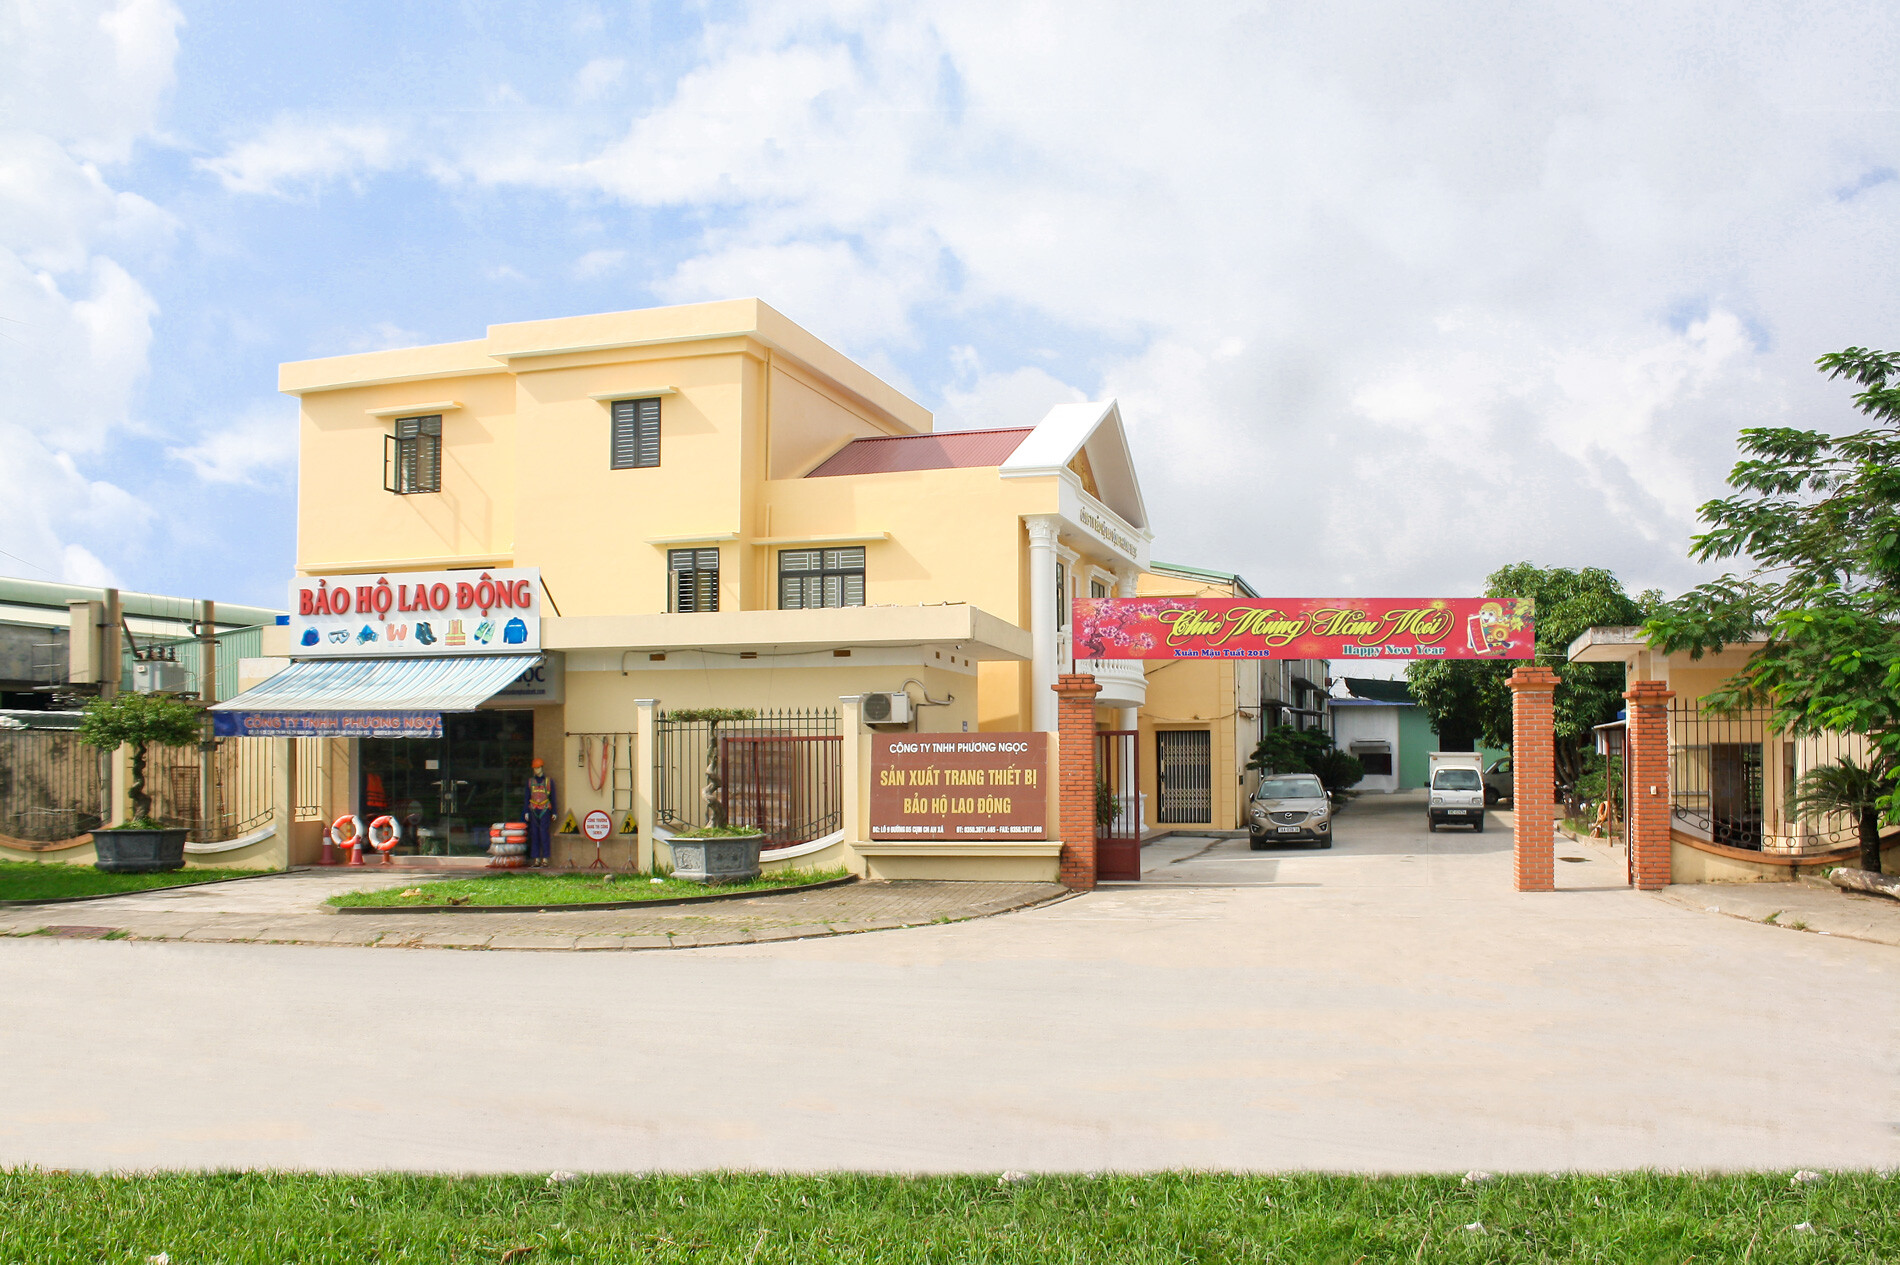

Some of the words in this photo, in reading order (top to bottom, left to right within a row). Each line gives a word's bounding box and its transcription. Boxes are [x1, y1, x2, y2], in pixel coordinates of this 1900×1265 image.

[298, 578, 350, 616] BẢO
[355, 576, 393, 621] HỘ
[397, 582, 450, 612] LAO
[455, 571, 531, 617] ĐỘNG
[1158, 609, 1226, 647] Chúc
[1205, 606, 1312, 647] Mừng
[1311, 608, 1386, 637] Năm
[1357, 608, 1456, 646] Mới
[1173, 649, 1199, 657] Xuân
[1201, 649, 1221, 659] Mậu
[1222, 647, 1245, 657] Tuất
[1247, 649, 1270, 657] 2018
[1342, 645, 1383, 657] Happy
[1385, 645, 1412, 655] New
[1414, 645, 1446, 655] Year
[244, 714, 281, 728] CÔNG
[283, 717, 299, 728] TY
[301, 717, 338, 728] TNHH
[342, 716, 401, 728] PHƯƠNG
[889, 741, 918, 754] CÔNG
[920, 743, 930, 753] TY
[932, 743, 955, 753] TNHH
[957, 742, 996, 753] PHƯƠNG
[998, 742, 1028, 755] NGỌC
[880, 765, 905, 786] SẢN
[908, 765, 940, 786] XUẤT
[944, 769, 985, 786] TRANG
[988, 763, 1022, 786] THIẾT
[1024, 769, 1037, 789] BỊ
[903, 792, 928, 814] BẢO
[931, 794, 948, 818] HỘ
[951, 798, 974, 814] LAO
[977, 794, 1011, 818] ĐỘNG
